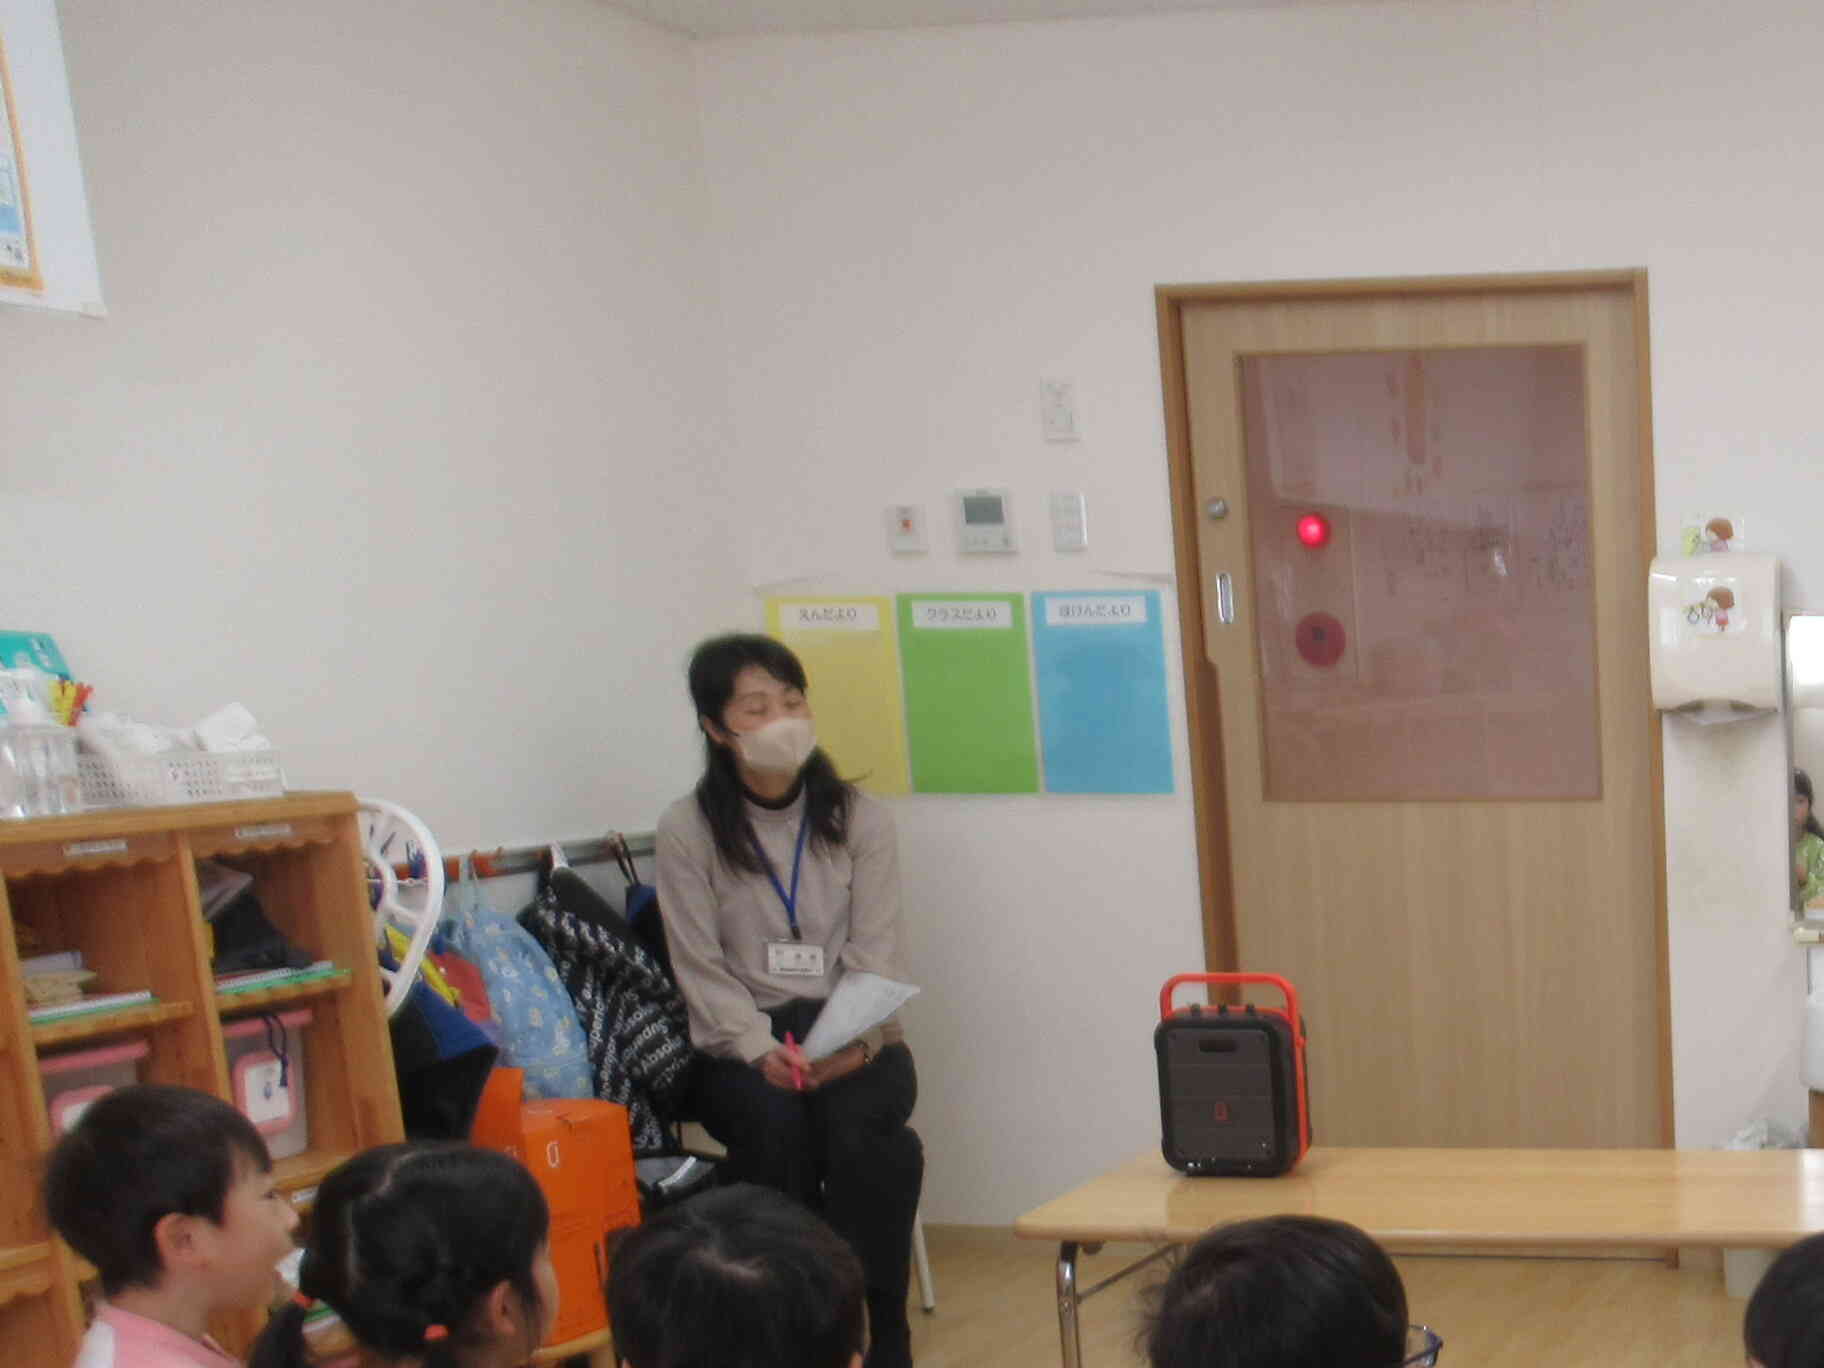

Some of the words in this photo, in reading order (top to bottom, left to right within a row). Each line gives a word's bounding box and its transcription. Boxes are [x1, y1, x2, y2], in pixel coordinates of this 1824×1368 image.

[799, 607, 857, 623] えんだより
[927, 607, 998, 623] クラスだより
